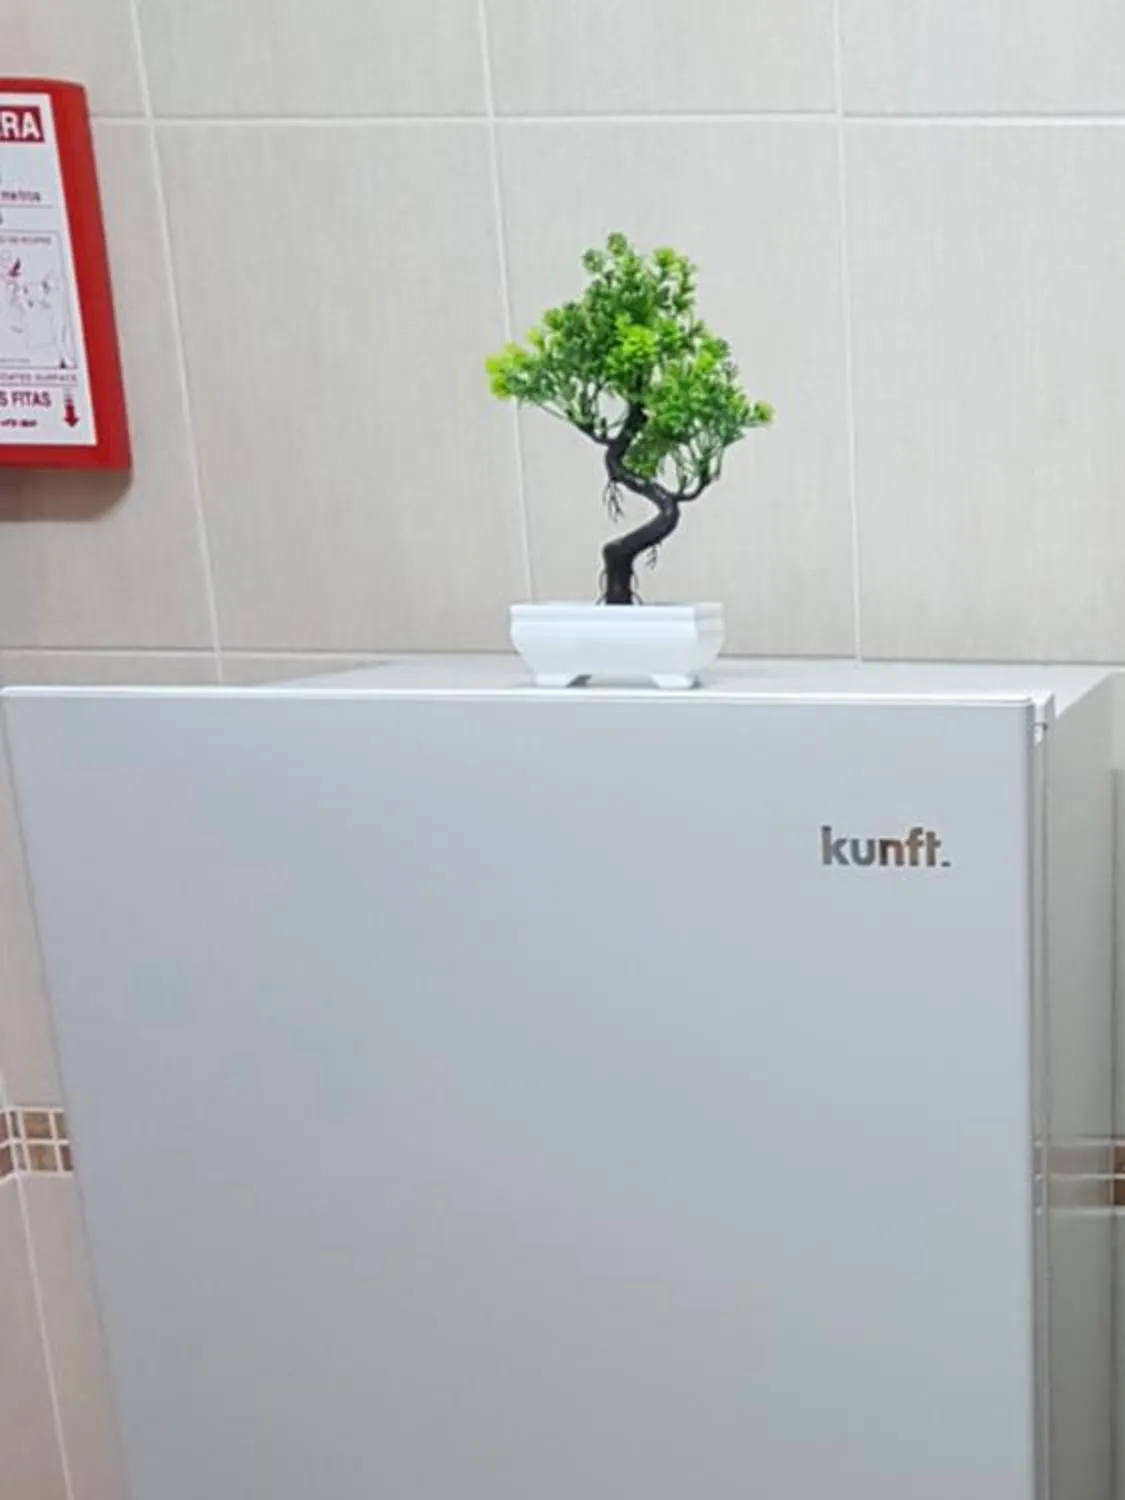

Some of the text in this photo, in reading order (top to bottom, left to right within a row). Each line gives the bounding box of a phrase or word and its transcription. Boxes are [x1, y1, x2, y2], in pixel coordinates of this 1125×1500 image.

[0, 111, 41, 139] RA
[11, 391, 52, 408] FITAS
[821, 825, 951, 867] kunft.
